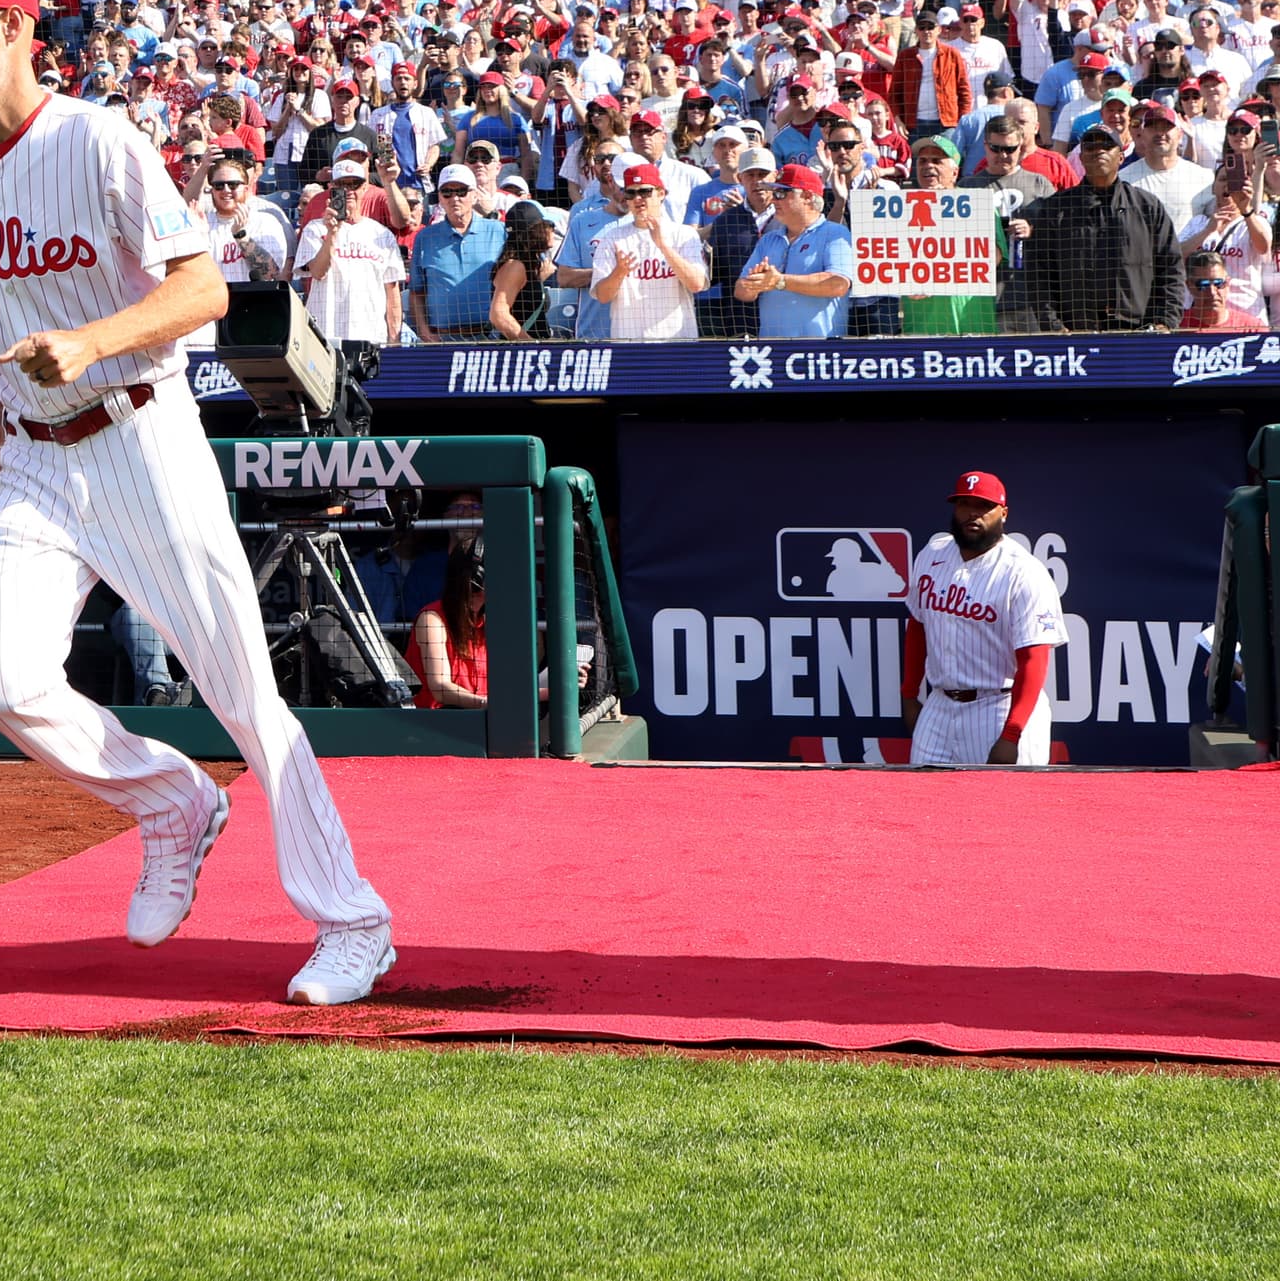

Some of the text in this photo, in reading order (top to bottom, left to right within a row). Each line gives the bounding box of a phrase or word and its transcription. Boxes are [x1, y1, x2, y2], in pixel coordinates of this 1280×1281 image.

[682, 43, 700, 60] P
[872, 194, 972, 219] 20 26
[856, 236, 990, 259] SEE YOU IN
[856, 261, 990, 284] OCTOBER
[448, 348, 612, 394] PHILLIES.COM
[785, 345, 1088, 381] Citizens Bank Park
[1172, 336, 1255, 379] GHOST
[233, 439, 426, 489] REMAX
[967, 475, 980, 491] P
[917, 573, 998, 624] Phillies
[652, 607, 902, 718] OPENI
